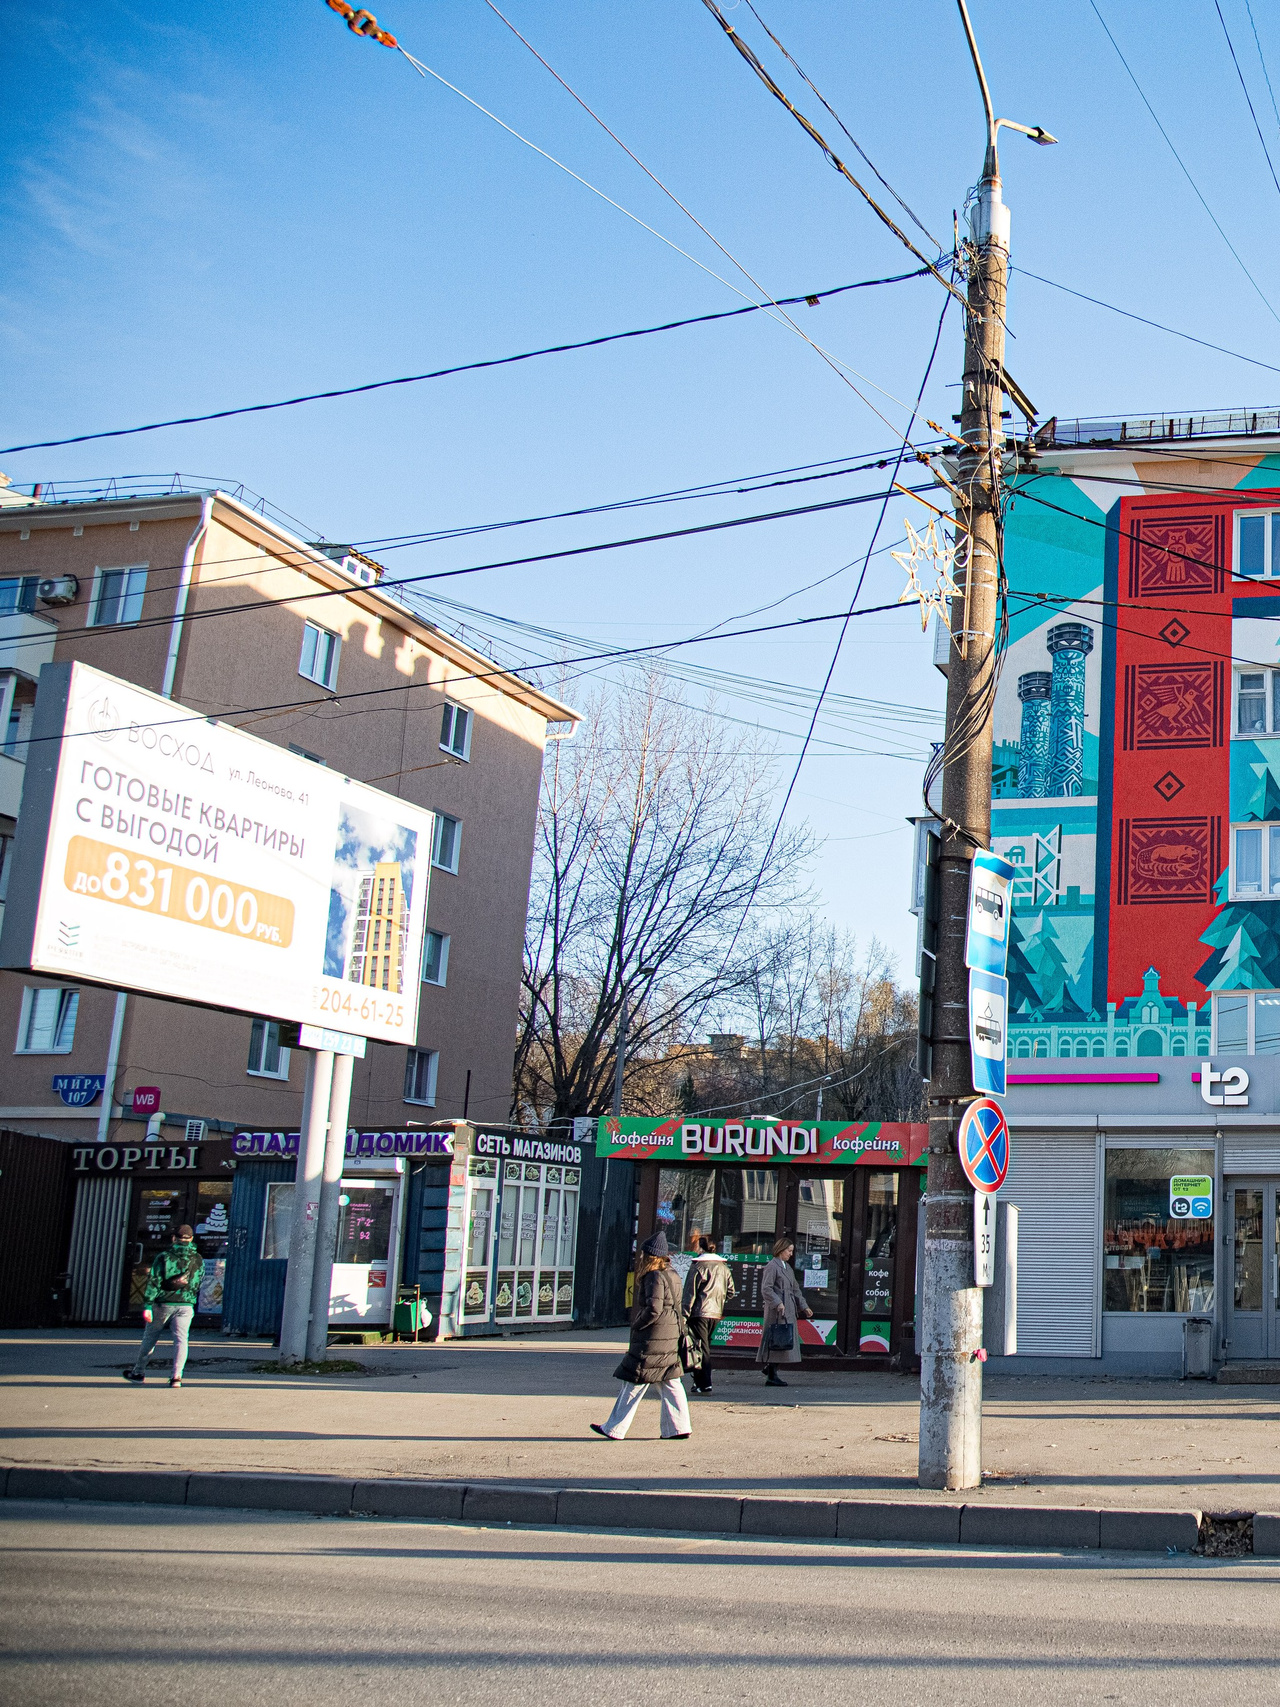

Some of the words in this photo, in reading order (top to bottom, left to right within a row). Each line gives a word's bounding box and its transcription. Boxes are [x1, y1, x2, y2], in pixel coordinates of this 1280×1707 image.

[128, 720, 215, 775] ВОСХОД
[229, 766, 243, 781] ул.
[298, 792, 309, 805] 41
[80, 759, 193, 820] ГОТОВЫЕ
[199, 802, 305, 859] КВАРТИРЫ
[75, 797, 93, 823] С
[101, 804, 219, 864] ВЫГОДОЙ
[101, 851, 174, 912] 831
[185, 876, 258, 934] 000
[319, 987, 404, 1028] 204-61-25
[57, 1078, 101, 1090] МИРА
[68, 1091, 87, 1103] 107
[1201, 1062, 1249, 1106] t2
[135, 1094, 155, 1106] WB
[356, 1130, 455, 1157] ДОМИК
[477, 1133, 511, 1155] СЕТЬ
[513, 1138, 582, 1164] МАГАЗИНОВ
[611, 1131, 674, 1147] кофейня
[682, 1124, 818, 1158] BURUNDI
[833, 1136, 900, 1151] кофейня
[73, 1146, 199, 1171] ТОРТЫ
[1175, 1201, 1188, 1213] t2
[981, 1234, 990, 1254] 35
[868, 1269, 889, 1278] кофе
[865, 1289, 890, 1297] собой
